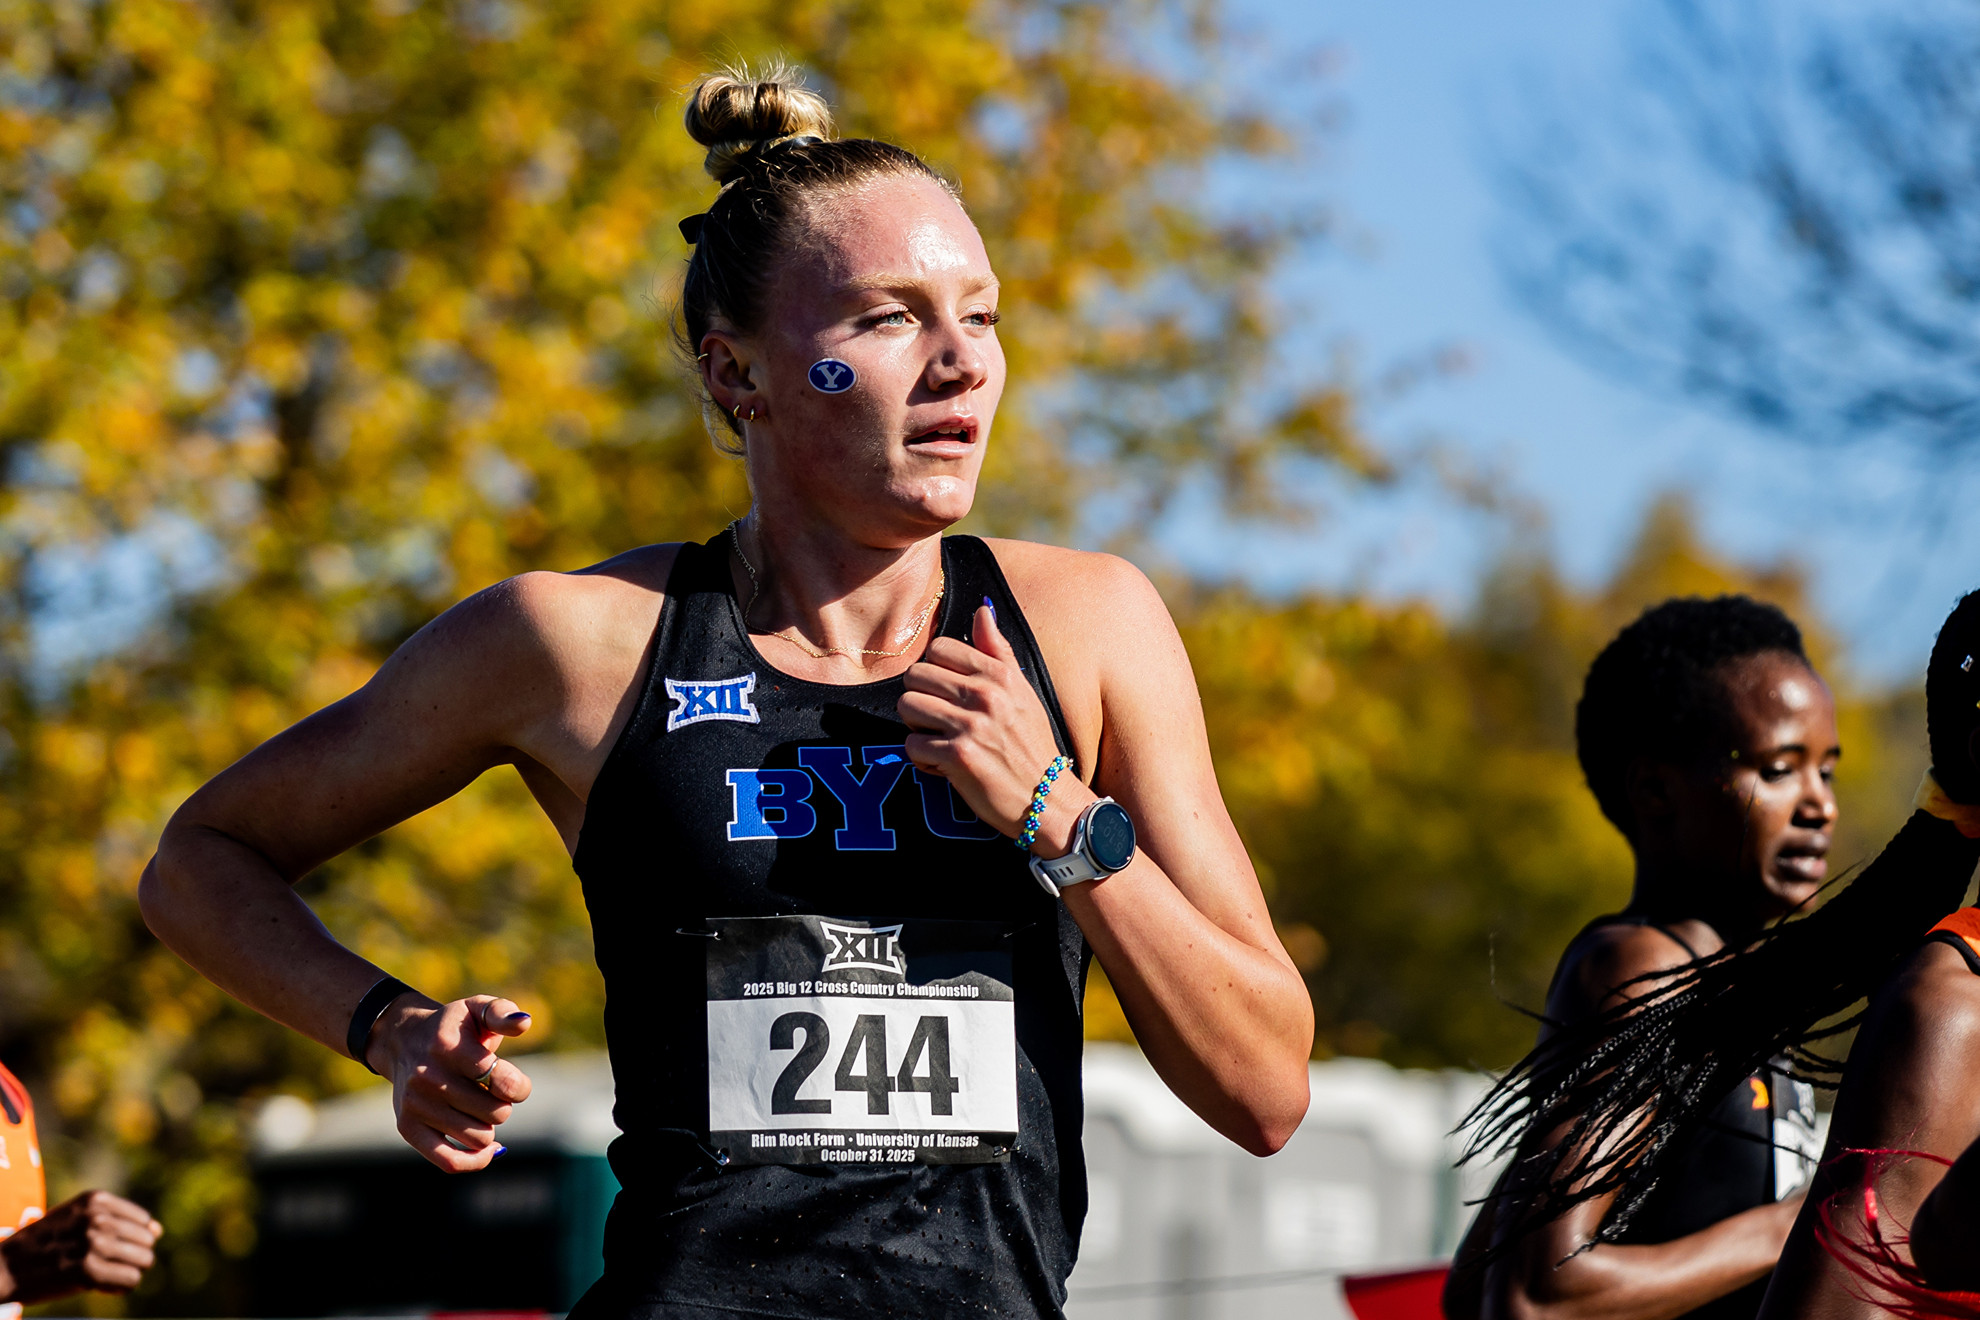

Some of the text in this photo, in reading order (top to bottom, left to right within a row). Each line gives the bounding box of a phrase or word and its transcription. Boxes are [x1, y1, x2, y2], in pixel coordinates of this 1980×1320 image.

[816, 363, 847, 389] Y
[743, 980, 979, 998] 2025 Big 12 Cross Country Championship
[769, 1011, 959, 1116] 244
[751, 1132, 979, 1148] Rim Rock Farm University of Kansas
[821, 1148, 916, 1162] October 31, 2025
